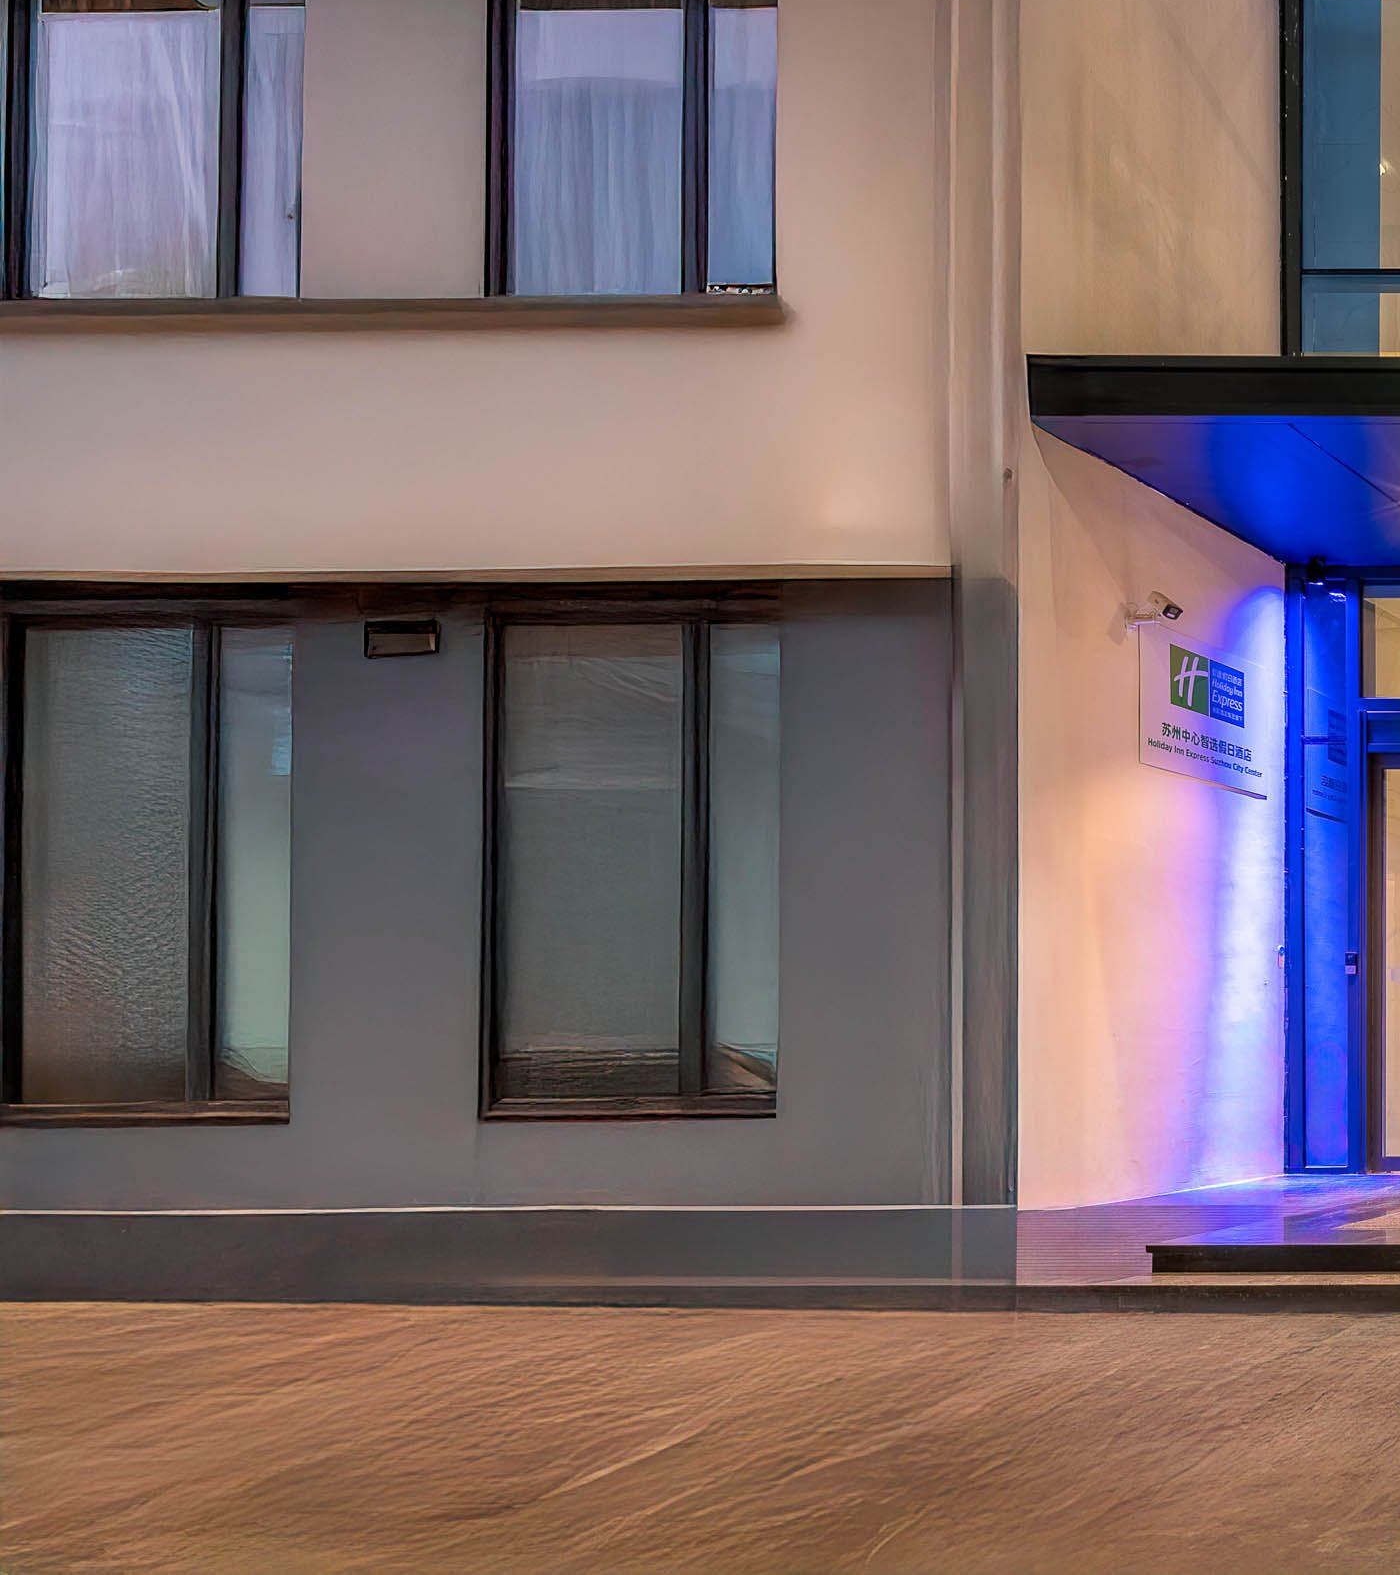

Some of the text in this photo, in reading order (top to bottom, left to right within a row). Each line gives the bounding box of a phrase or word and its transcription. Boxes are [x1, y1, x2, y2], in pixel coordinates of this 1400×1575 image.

[1212, 689, 1243, 712] Express
[1147, 737, 1173, 753] Holiday
[1174, 745, 1185, 756] Inn
[1186, 749, 1210, 763] Express
[1210, 756, 1232, 769] Suzhou
[1233, 763, 1243, 774] City
[1162, 722, 1252, 762] 苏州中心智选假日酒店
